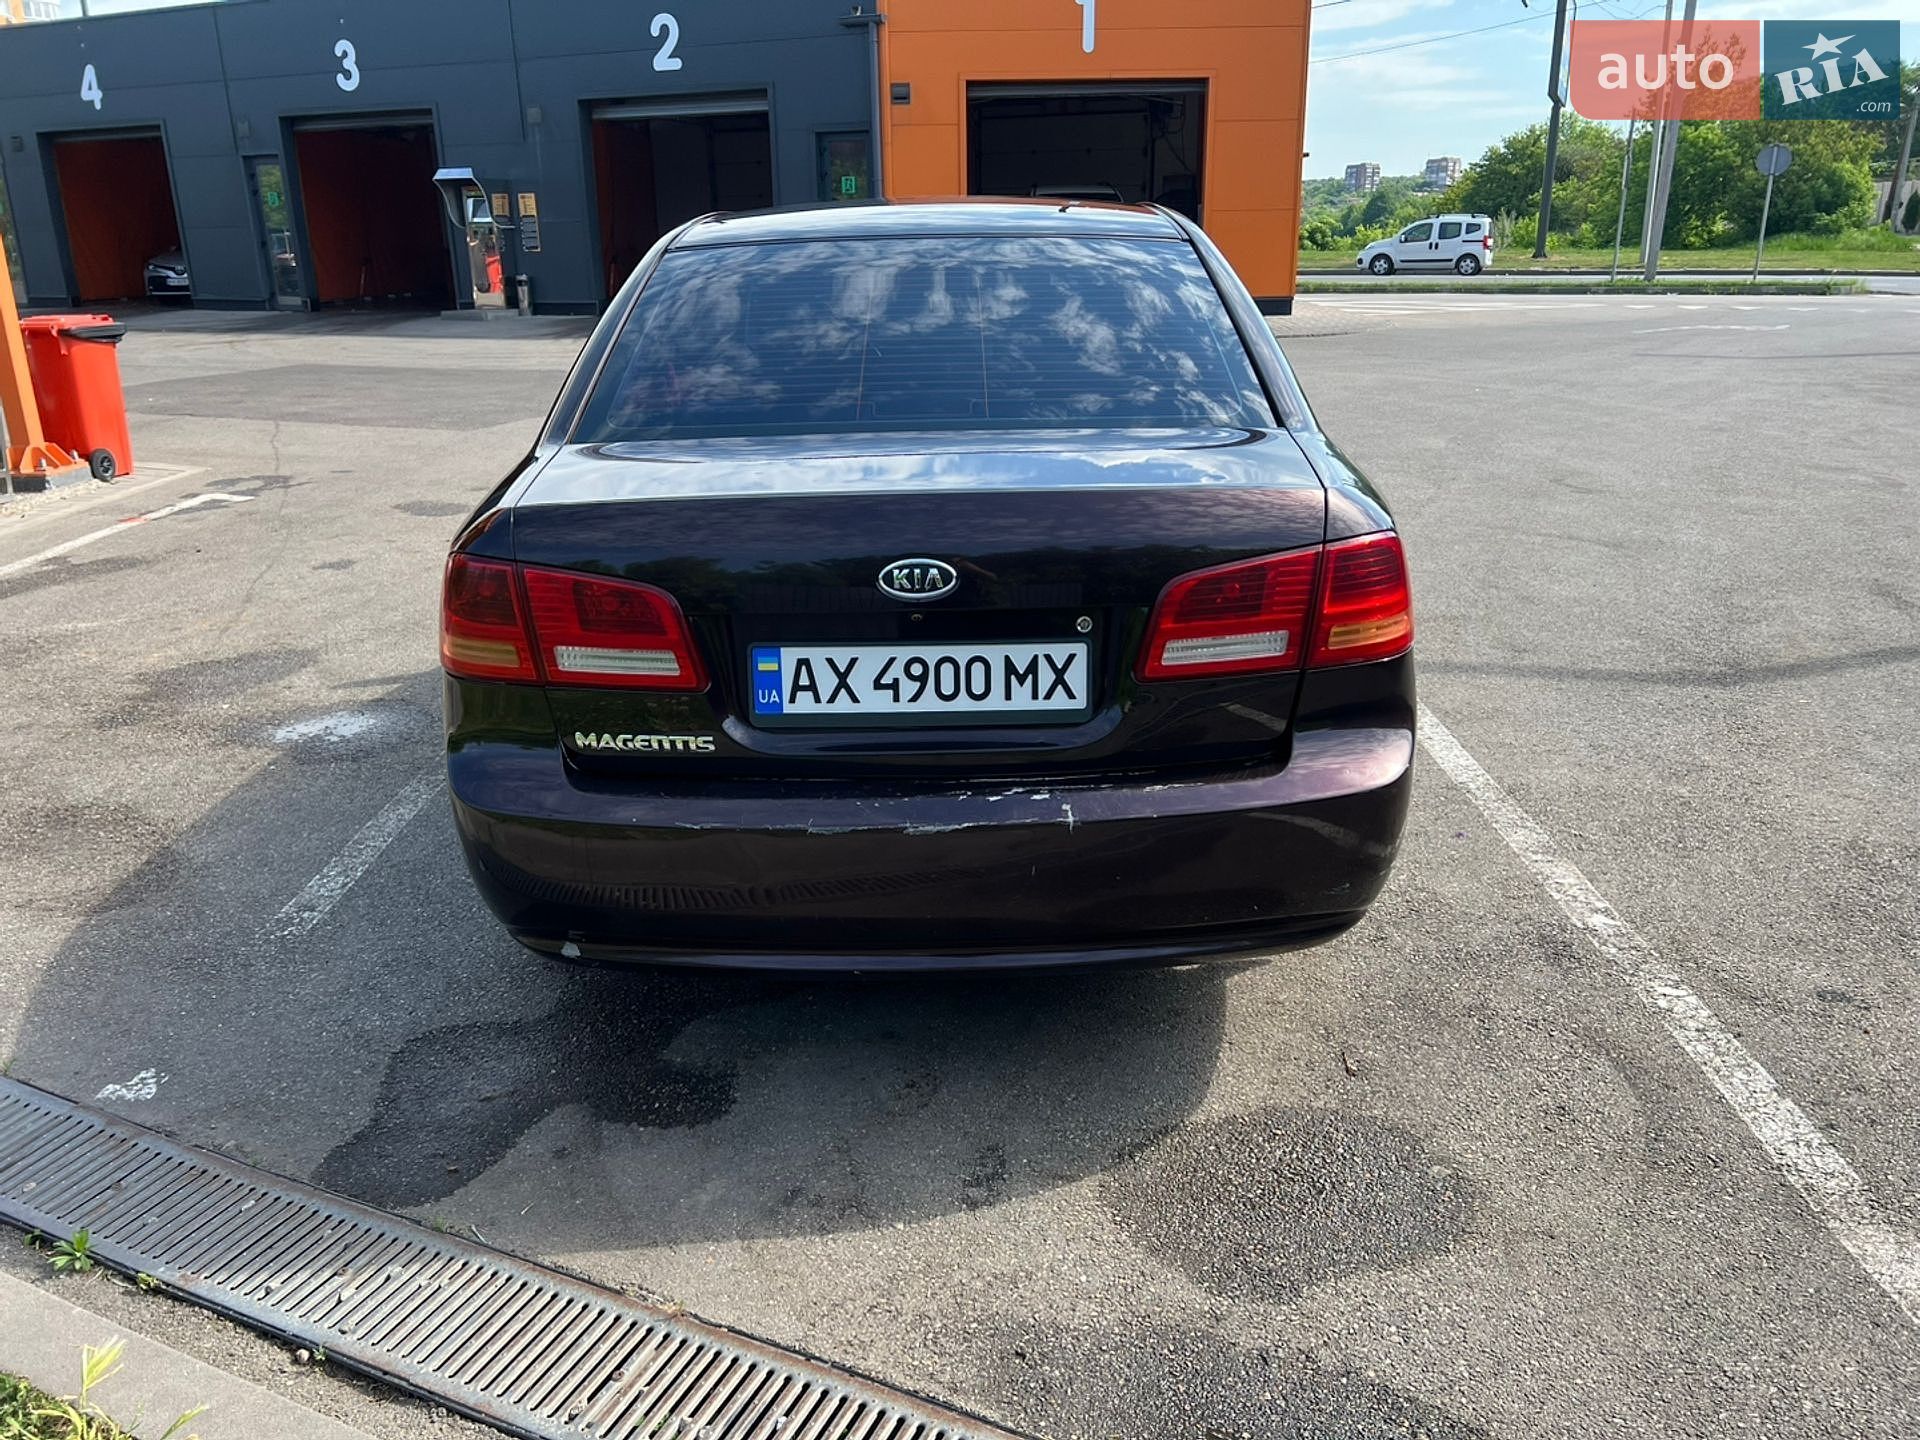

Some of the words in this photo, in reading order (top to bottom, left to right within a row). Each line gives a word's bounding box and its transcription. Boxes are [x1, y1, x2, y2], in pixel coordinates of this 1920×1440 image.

[334, 39, 360, 92] 3
[650, 13, 682, 72] 2
[80, 63, 103, 111] 4
[892, 568, 943, 591] KIA
[758, 689, 780, 704] UA
[788, 657, 861, 704] AX
[873, 655, 992, 703] 4900
[1004, 653, 1078, 701] MX
[574, 731, 716, 752] MAGENTIS
